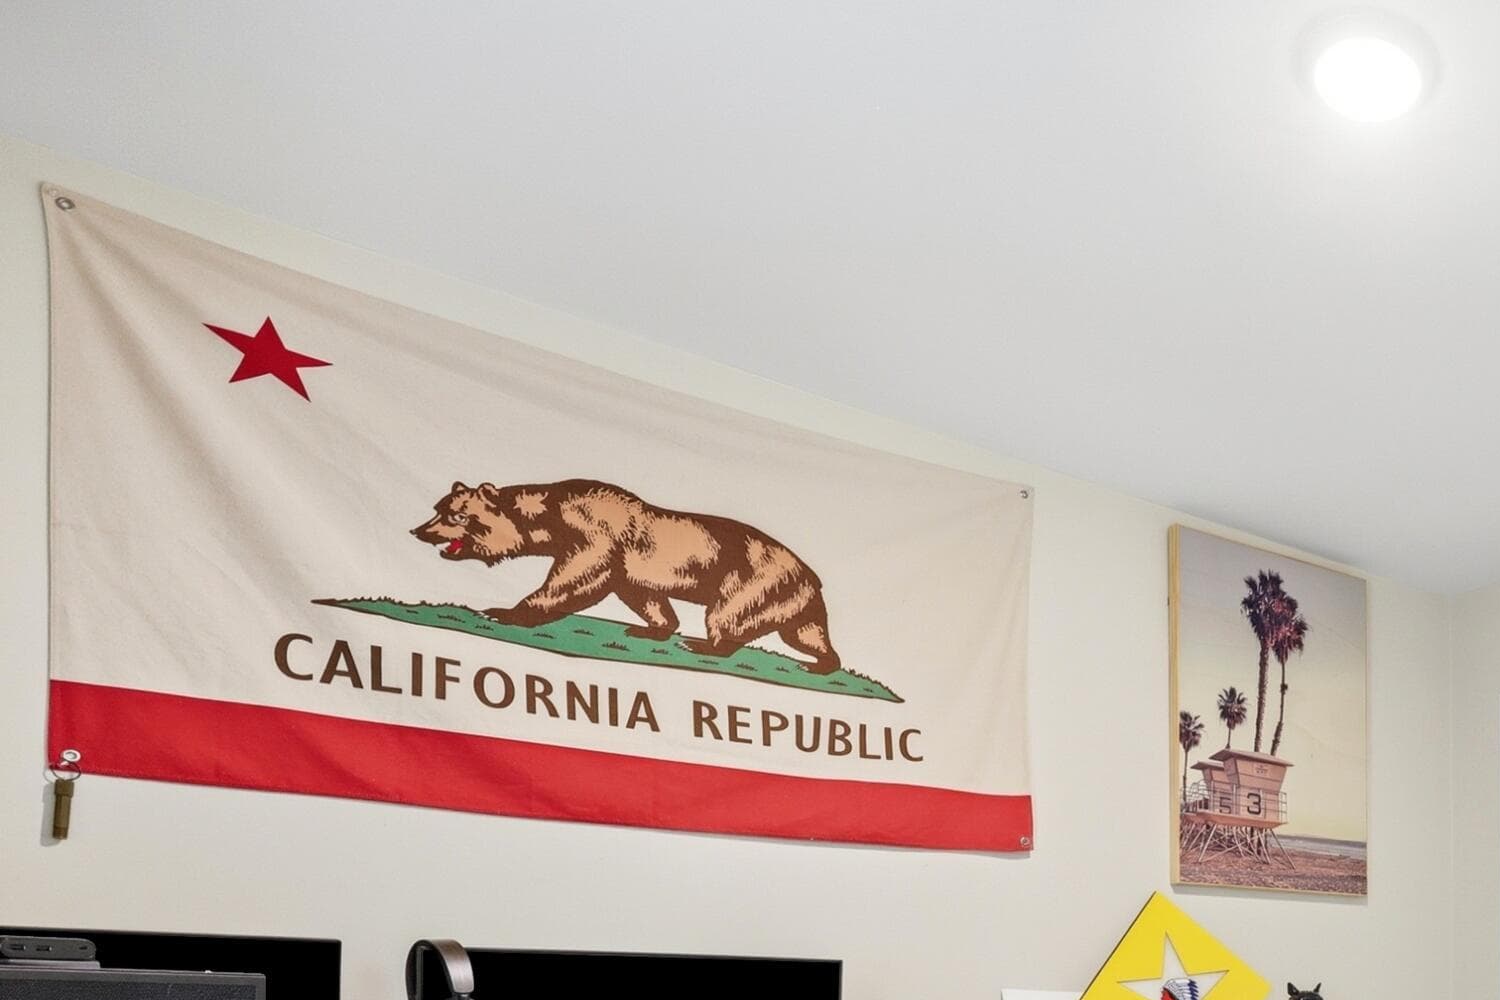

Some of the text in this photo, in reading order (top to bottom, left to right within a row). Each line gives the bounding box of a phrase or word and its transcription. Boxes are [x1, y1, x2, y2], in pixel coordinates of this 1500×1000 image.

[274, 633, 924, 762] CALIFORNIA REPUBLIC
[1247, 793, 1261, 815] 3
